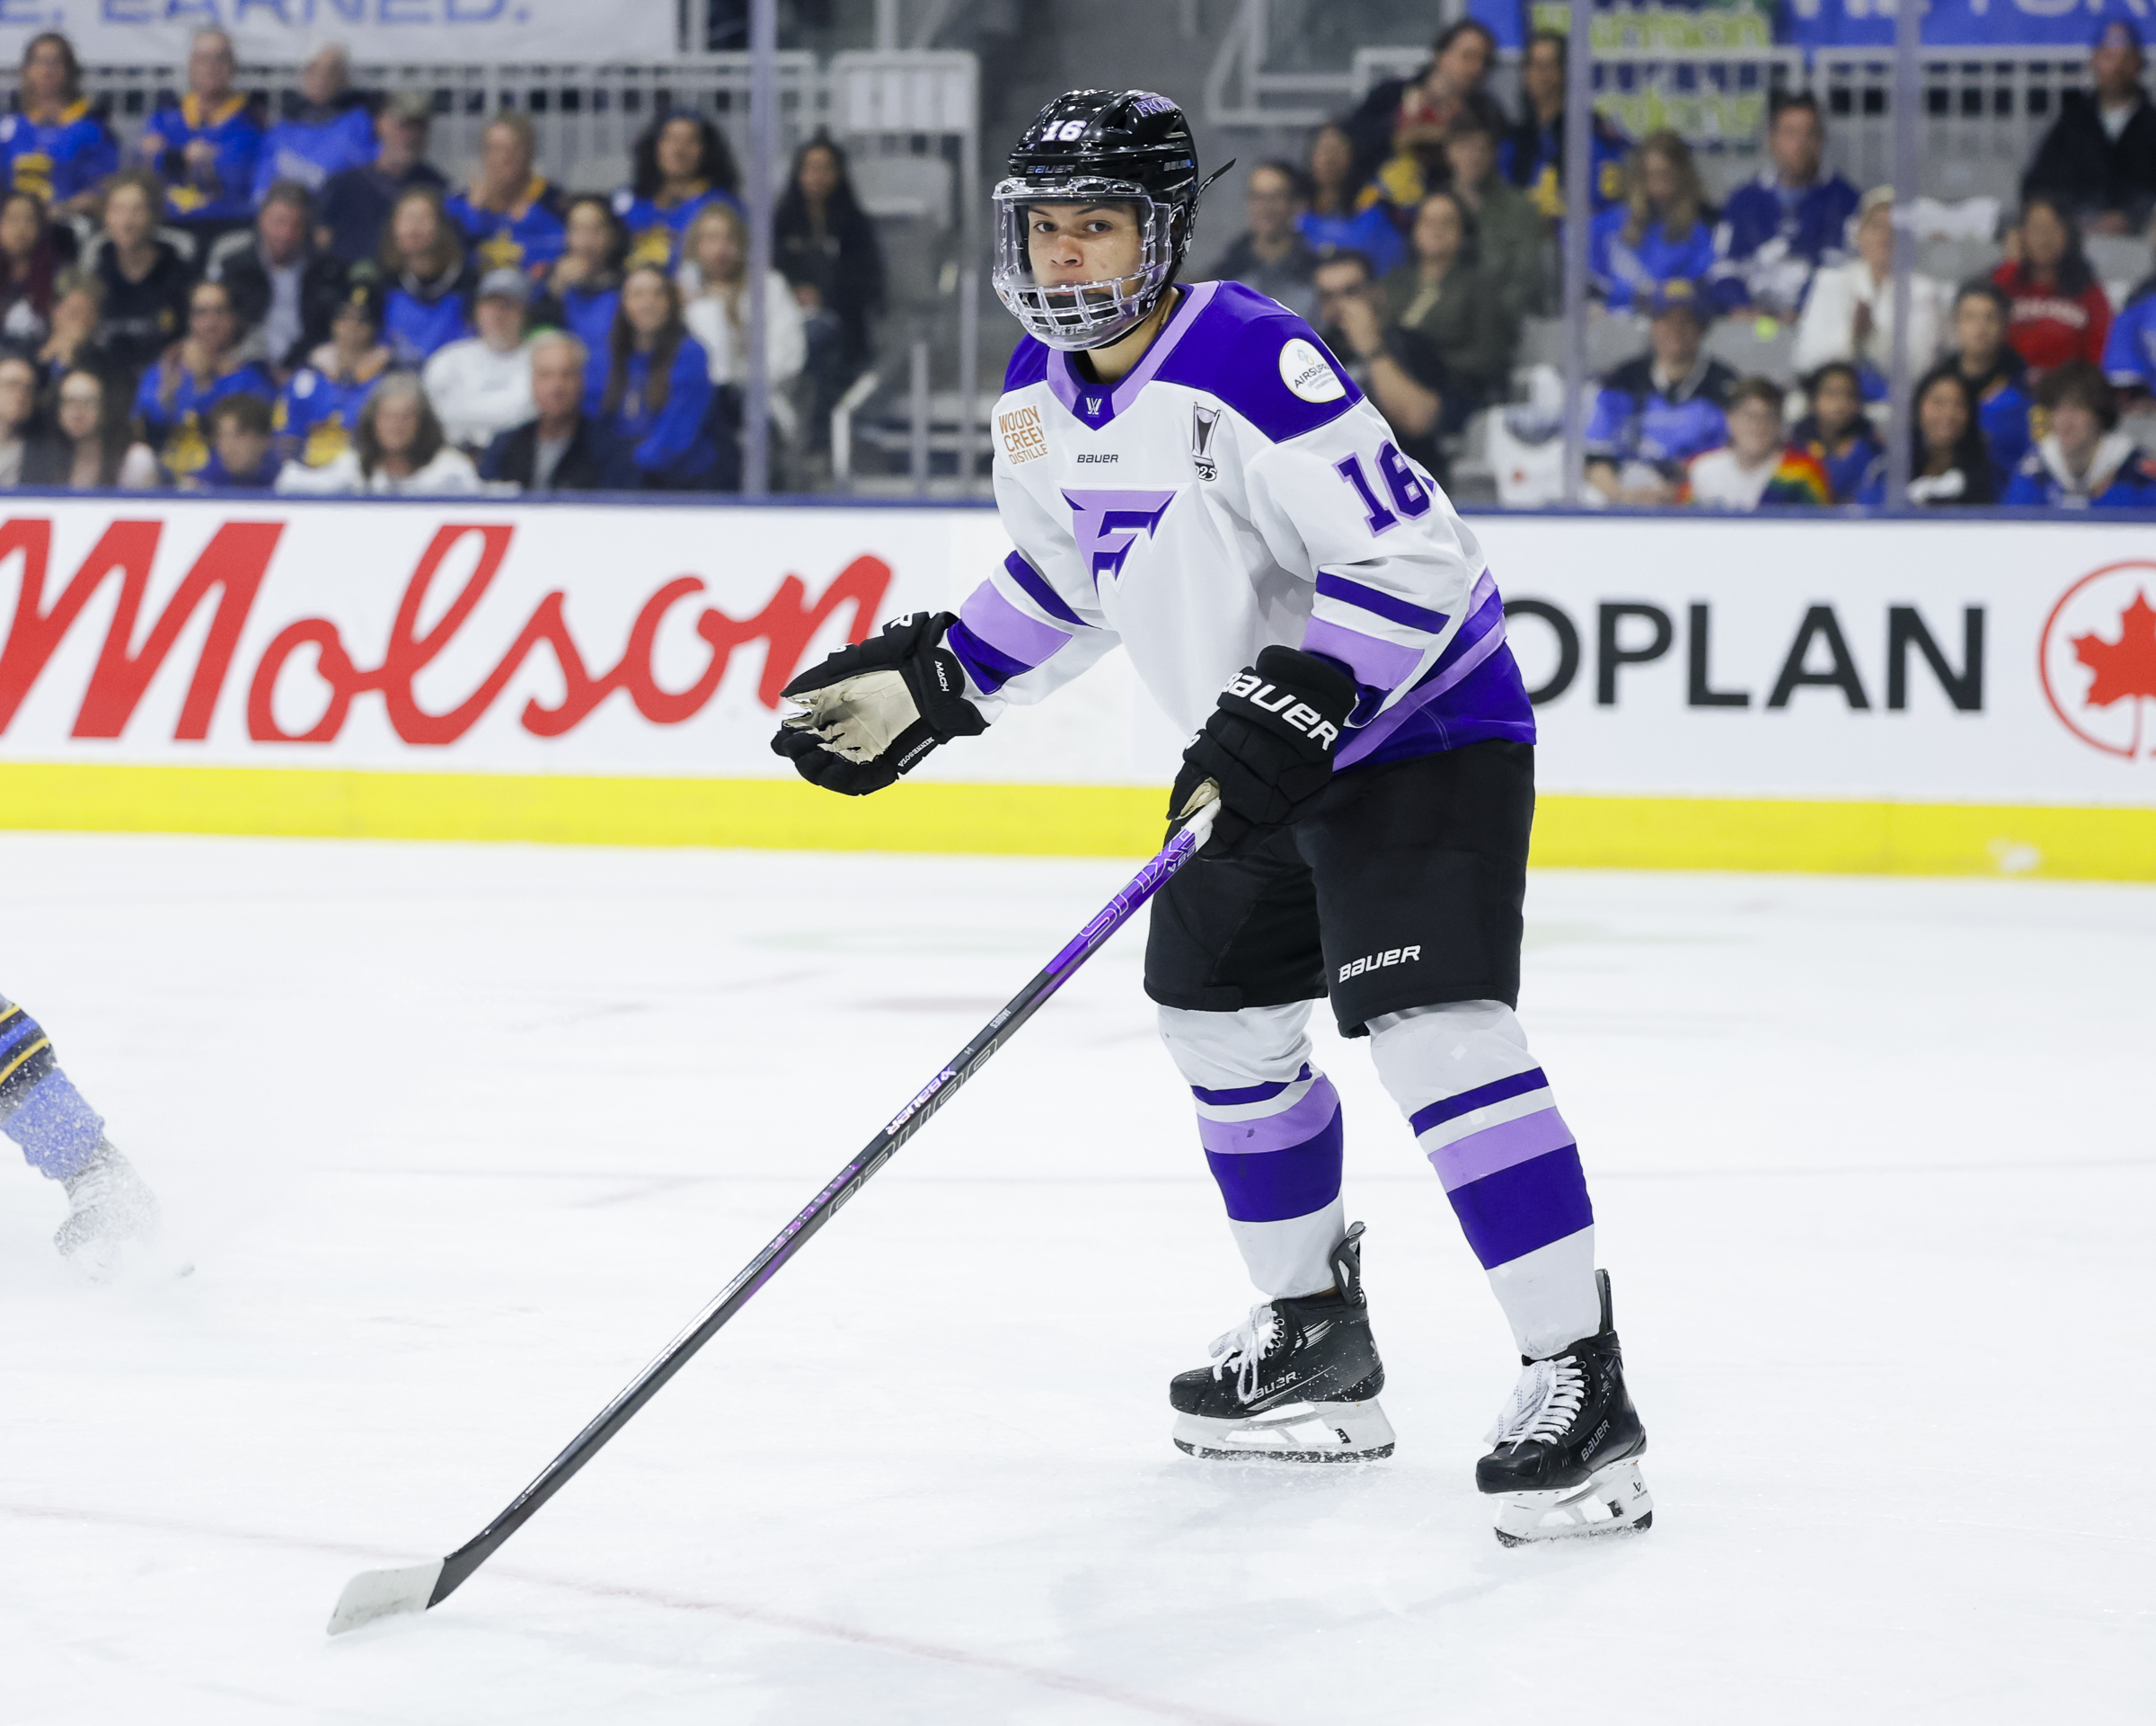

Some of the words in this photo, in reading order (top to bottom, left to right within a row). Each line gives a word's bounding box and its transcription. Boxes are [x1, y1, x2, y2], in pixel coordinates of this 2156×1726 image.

[1041, 119, 1088, 142] 16
[998, 405, 1040, 434] WOODY
[1076, 454, 1118, 464] BAUER
[1331, 438, 1432, 539] 16
[0, 518, 893, 745] Molson
[934, 660, 950, 692] MACH
[898, 736, 935, 768] MINNESOTA
[1338, 944, 1421, 984] BAUER
[1244, 1371, 1297, 1405] AUER
[1580, 1419, 1611, 1463] BAUER
